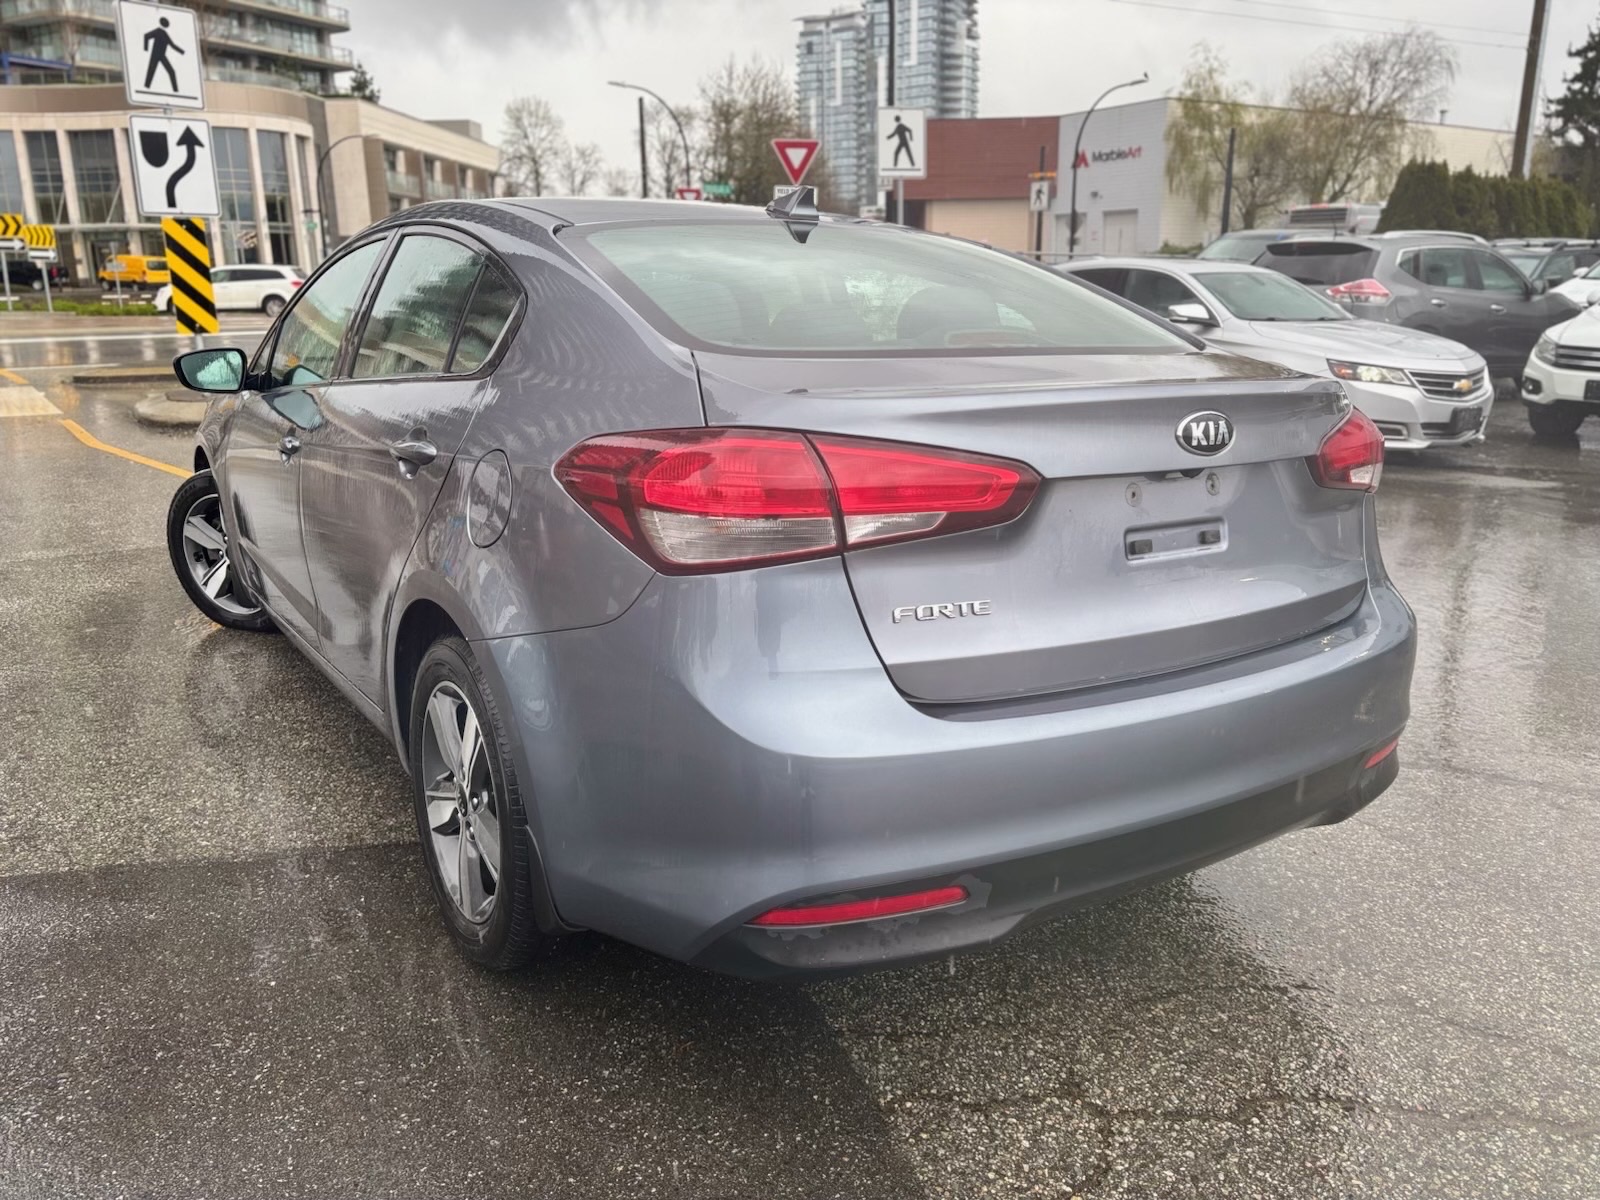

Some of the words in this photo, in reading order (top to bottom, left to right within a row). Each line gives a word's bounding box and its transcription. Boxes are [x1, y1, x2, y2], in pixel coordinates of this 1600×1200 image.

[1092, 146, 1142, 162] MarbleArt
[1190, 420, 1230, 446] KIA
[892, 599, 992, 624] FORTE
